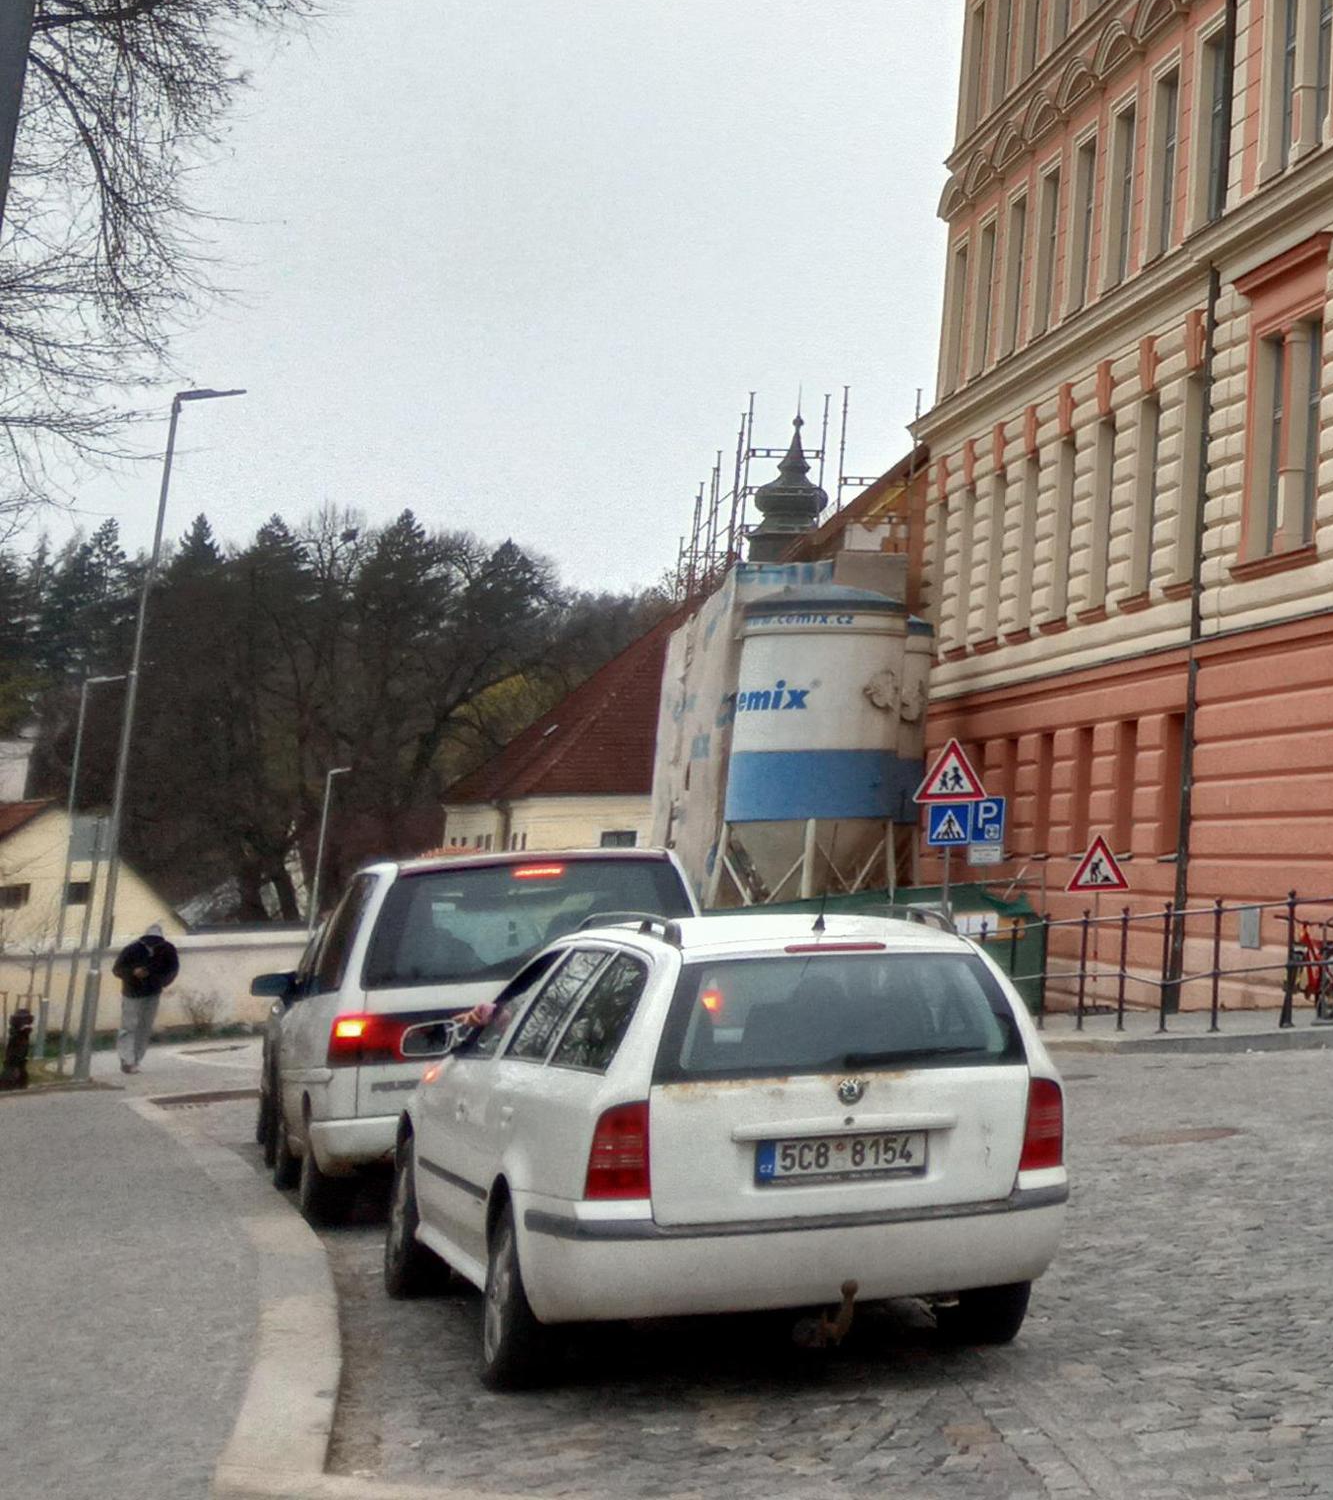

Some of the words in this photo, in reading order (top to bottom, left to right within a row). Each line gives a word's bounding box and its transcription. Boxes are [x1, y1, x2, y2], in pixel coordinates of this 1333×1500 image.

[978, 802, 998, 828] P
[781, 1142, 831, 1172] 5C8
[852, 1136, 913, 1167] 8154
